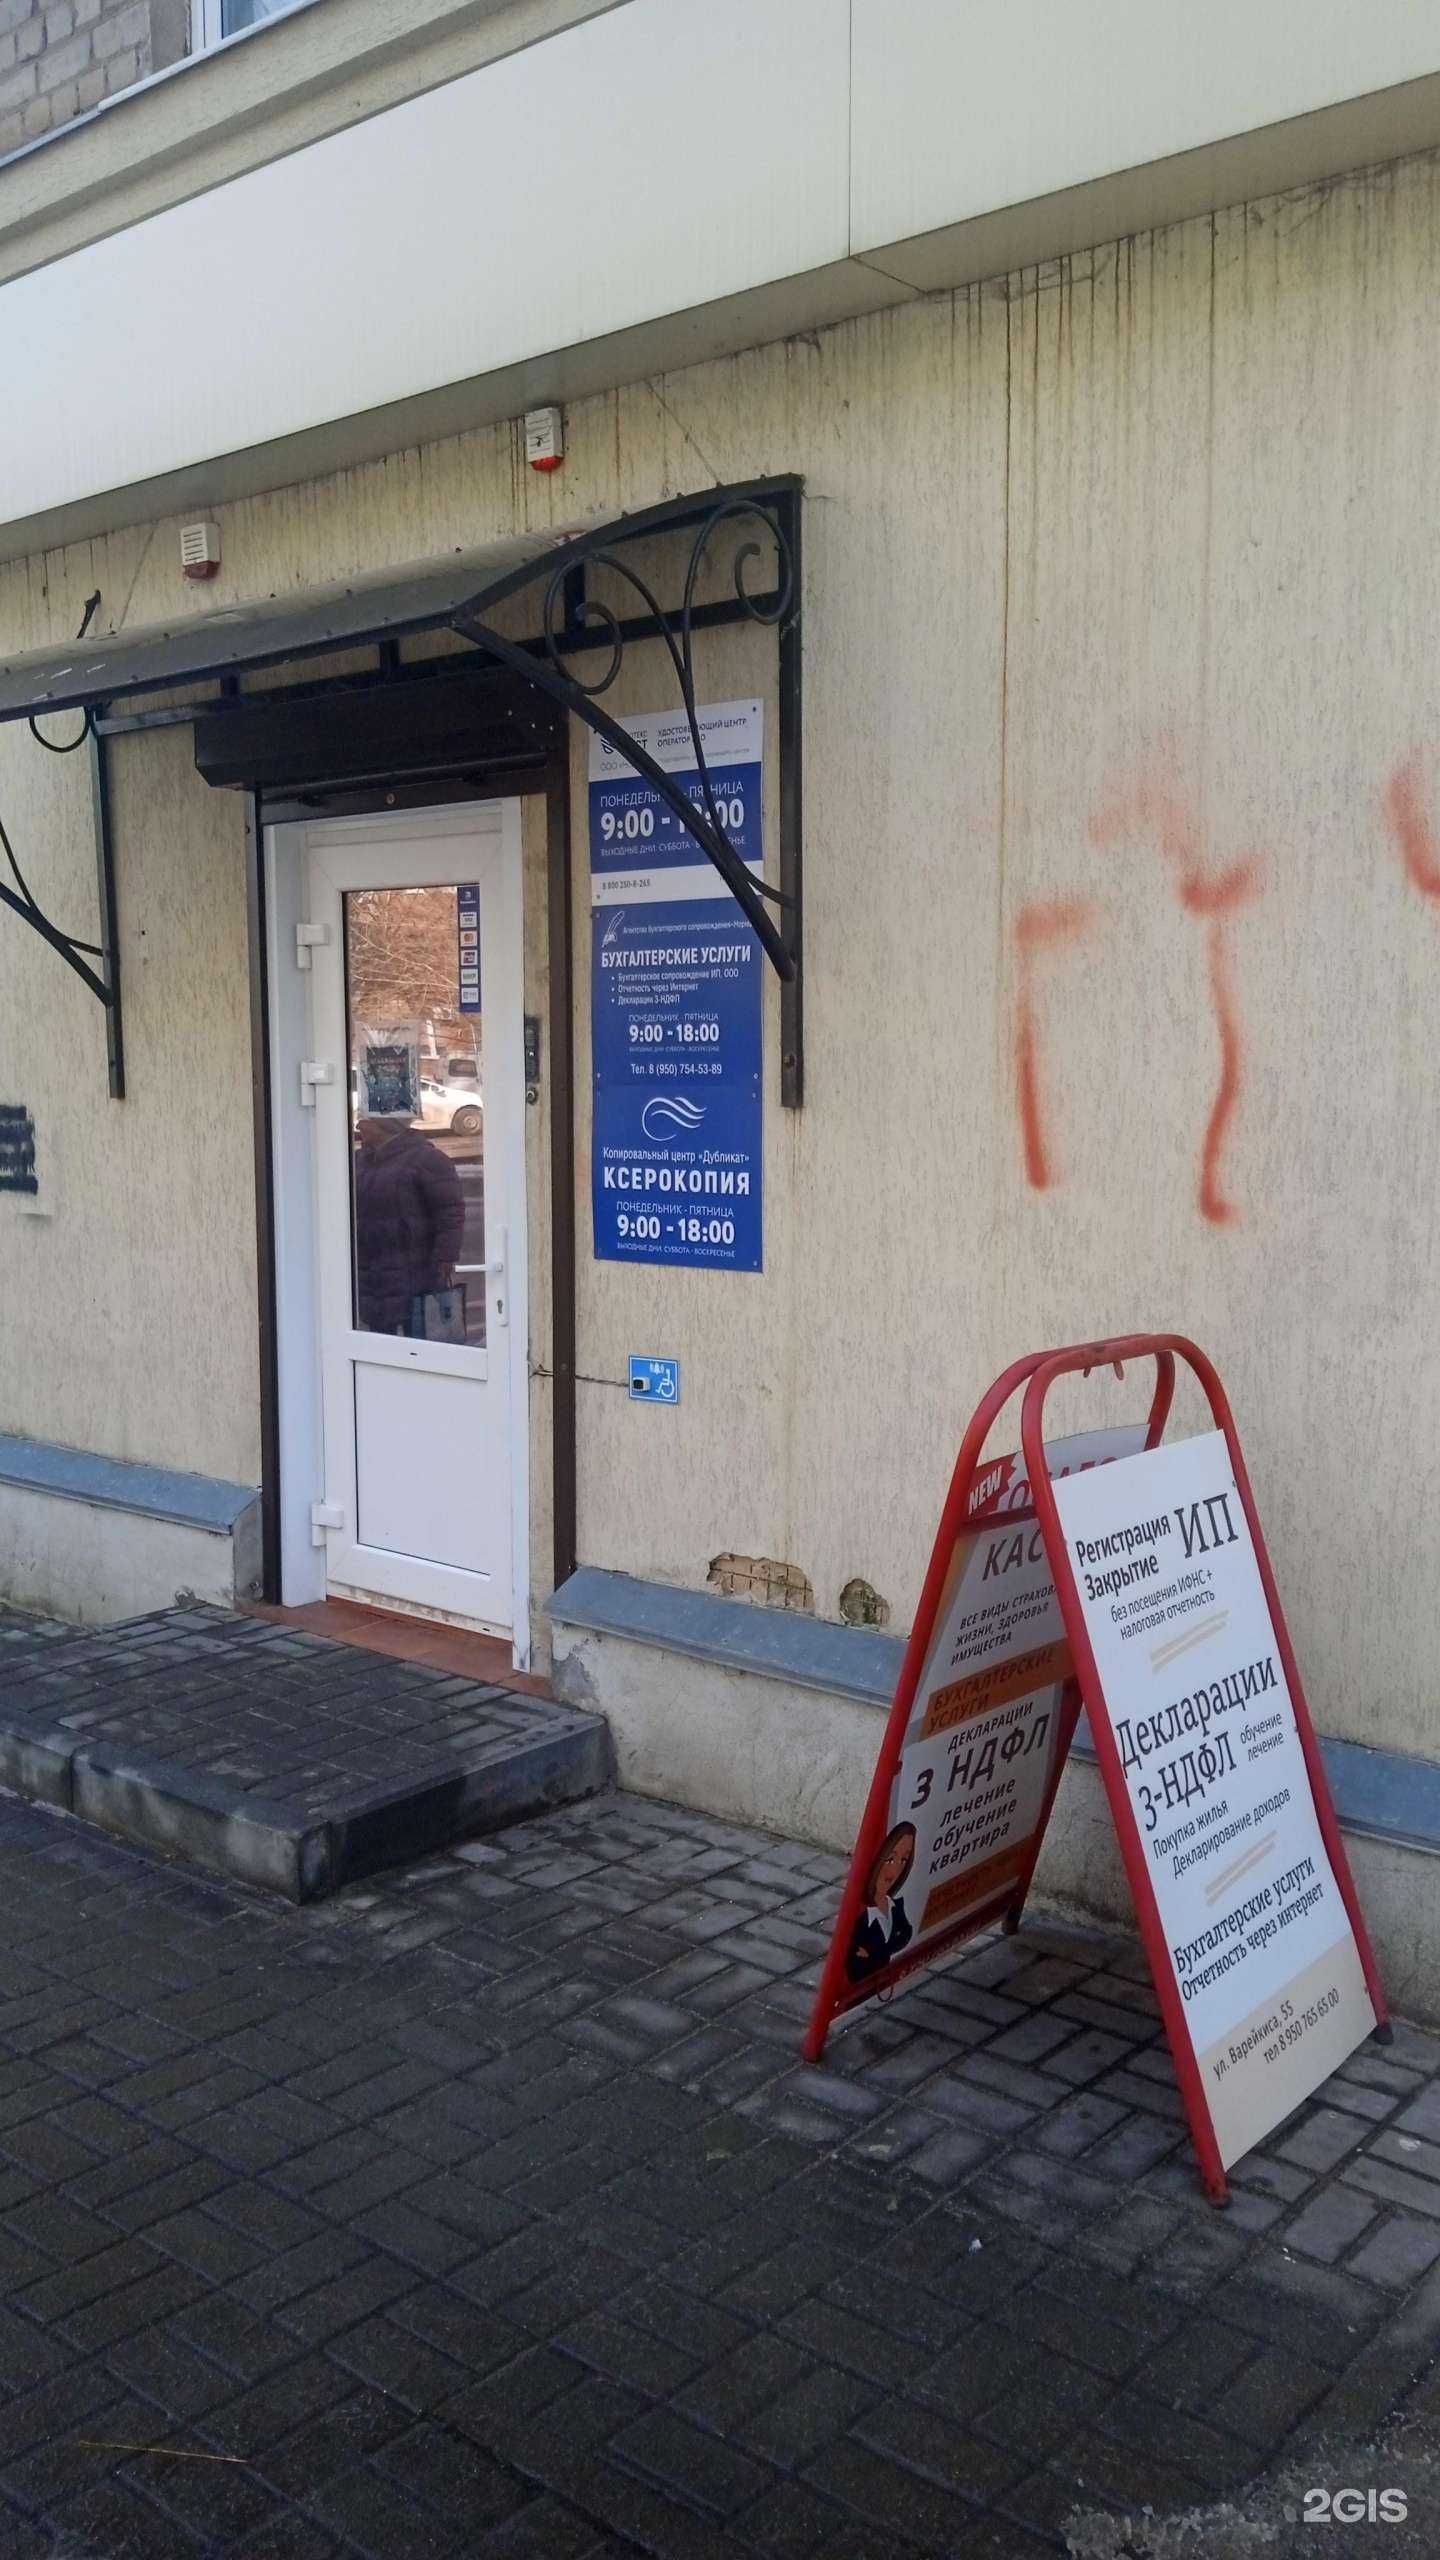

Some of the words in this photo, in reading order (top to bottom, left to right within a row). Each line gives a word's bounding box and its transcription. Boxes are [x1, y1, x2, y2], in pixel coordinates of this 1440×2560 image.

[689, 781, 744, 799] ПЯНИЦА
[601, 808, 654, 840] 9:00
[601, 948, 698, 968] БУХГАЛТЕРСКИЕ
[701, 945, 751, 964] УСЛУГИ
[724, 968, 739, 978] ООО
[629, 1024, 663, 1042] 9:00
[676, 1023, 719, 1042] 18:00
[648, 1063, 654, 1074] 8
[656, 1063, 678, 1076] (950)
[680, 1063, 722, 1075] 754-53-89
[603, 1147, 669, 1161] Копировальный
[671, 1151, 696, 1162] центр
[604, 1166, 750, 1196] КСЕРОКОПИЯ
[616, 1201, 682, 1214] ПОНЕДЕЛЬНИК
[689, 1205, 734, 1218] ПЯТНИЦА
[617, 1214, 661, 1239] 9:00
[678, 1218, 735, 1245] 18:00
[968, 1464, 1003, 1515] NEW
[1075, 1515, 1171, 1567] Регистрация
[1174, 1492, 1239, 1559] ИП
[1084, 1554, 1160, 1601] Закрытие
[1111, 1604, 1128, 1623] без
[1129, 1584, 1178, 1616] посещения
[1178, 1568, 1206, 1592] ИФНС
[955, 1623, 994, 1647] ЖИЗНИ,
[998, 1602, 1049, 1630] ЗДОРОВЬЯ
[960, 1612, 978, 1630] ВСЕ
[980, 1600, 1010, 1621] ВИДЫ
[1120, 1611, 1166, 1640] налоговая
[1166, 1589, 1215, 1620] отчетность
[950, 1631, 1012, 1666] ИМУЩЕСТВА
[933, 1652, 1053, 1711] БУХГАЛТЕРСКИЕ
[929, 1694, 990, 1733] УСЛУГИ
[948, 1701, 1033, 1754] ДЕКЛАРАЦИИ
[1116, 1656, 1278, 1779] Декларации
[1240, 1712, 1283, 1745] обучение
[910, 1767, 934, 1810] 3
[947, 1713, 1050, 1793] НДФЛ
[1247, 1730, 1285, 1762] лечение
[939, 1779, 1016, 1827] лечение
[1138, 1730, 1237, 1832] 3-НДФЛ
[929, 1821, 1010, 1875] квартира
[932, 1799, 1017, 1852] обучение
[1153, 1821, 1196, 1859] Покупка
[1196, 1800, 1229, 1829] жилья
[1172, 1812, 1252, 1879] Декларирование
[1253, 1787, 1291, 1826] доходов
[1173, 1886, 1273, 1974] Бухгалтерские
[1273, 1856, 1315, 1907] услуги
[1181, 1942, 1248, 2001] Отчетность
[1248, 1919, 1278, 1953] через
[1279, 1882, 1324, 1930] интернет
[1264, 2043, 1280, 2065] тел
[1278, 2032, 1286, 2046] 8
[1286, 2019, 1303, 2042] 950
[1302, 2007, 1319, 2030] 765
[1317, 1996, 1328, 2016] 65
[1327, 1987, 1340, 2006] 00
[1280, 1999, 1295, 2020] 55
